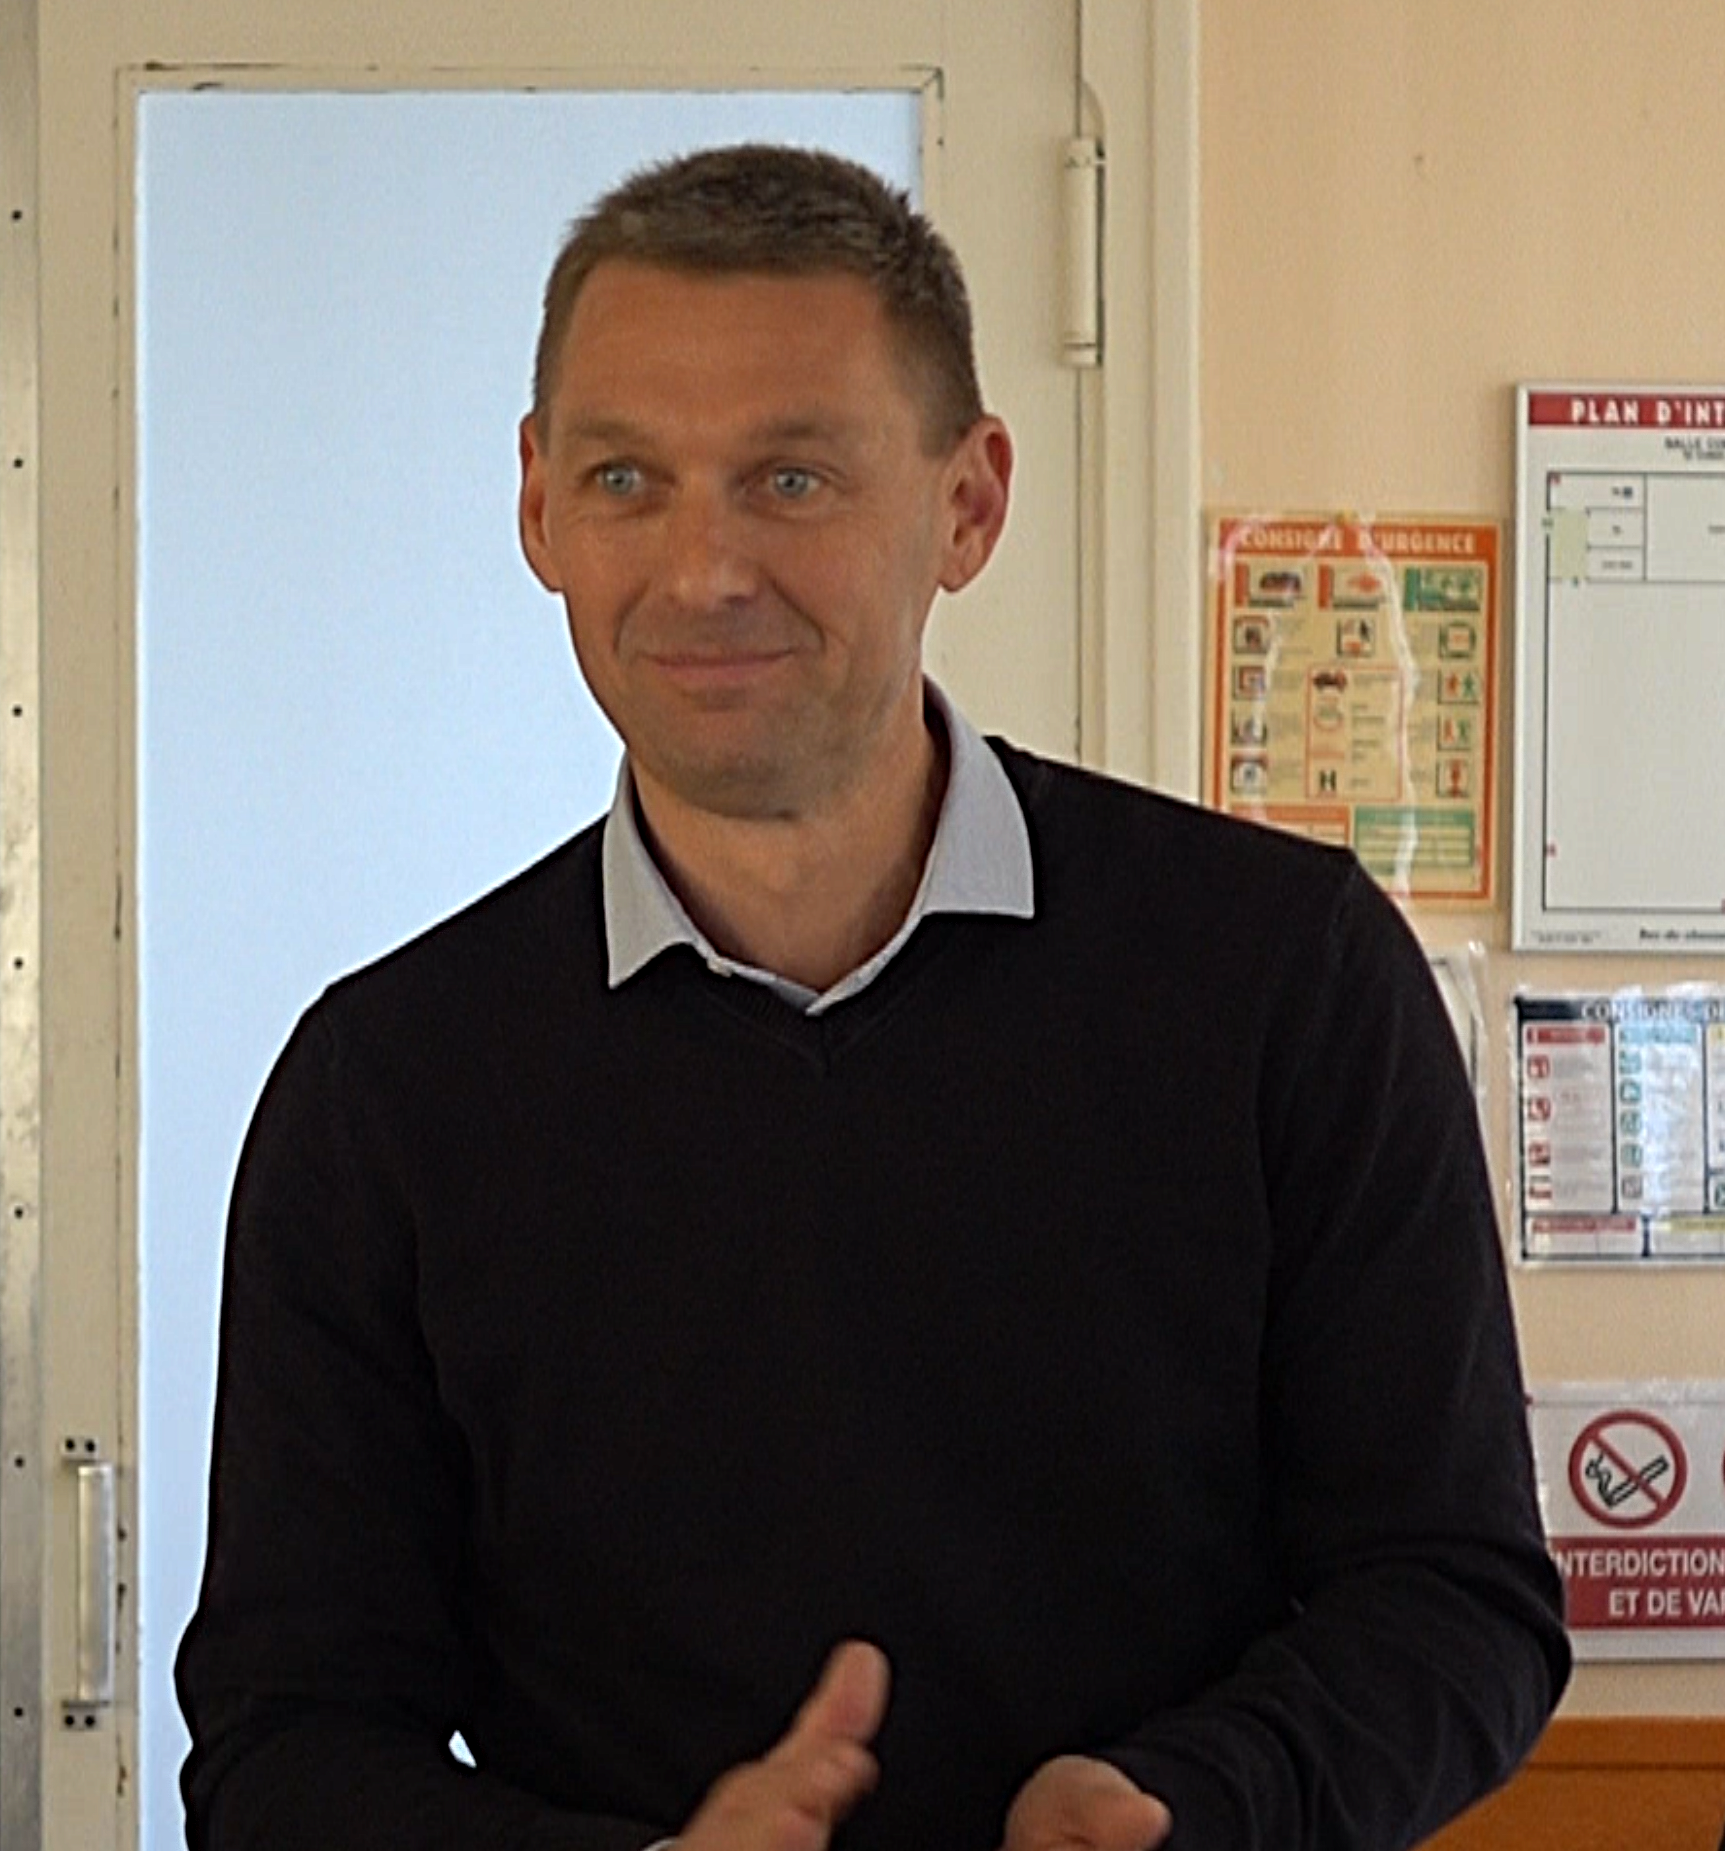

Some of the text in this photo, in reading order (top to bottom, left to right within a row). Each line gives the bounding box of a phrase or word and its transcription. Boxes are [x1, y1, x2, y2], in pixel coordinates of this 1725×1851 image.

[1571, 398, 1639, 424] PLAN
[1551, 1549, 1725, 1578] NTERDICTION
[1608, 1588, 1640, 1617] ET
[1646, 1588, 1682, 1617] DE
